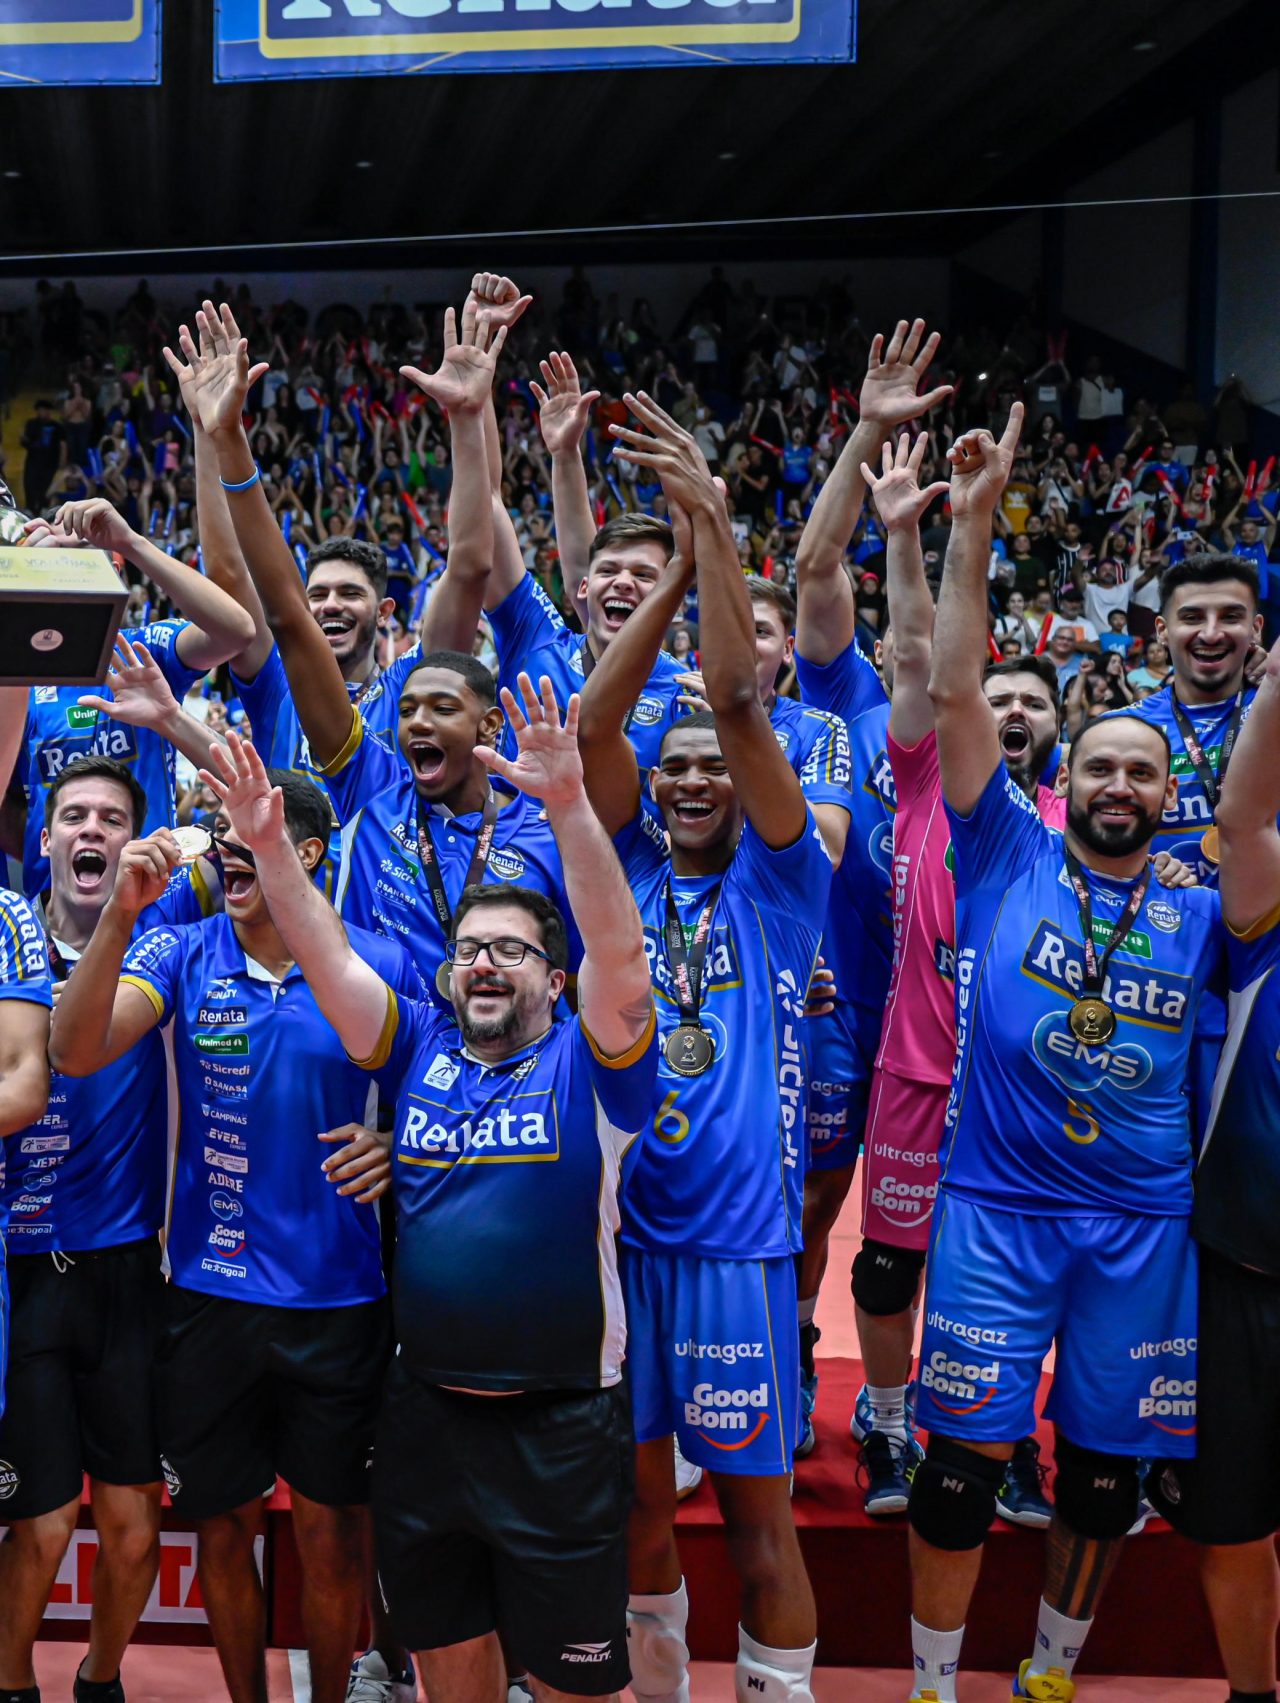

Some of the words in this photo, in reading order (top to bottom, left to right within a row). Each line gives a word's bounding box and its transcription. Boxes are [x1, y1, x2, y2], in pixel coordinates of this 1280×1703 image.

[73, 710, 98, 719] Unim
[42, 729, 130, 776] Reta
[1174, 751, 1216, 765] Und
[392, 822, 419, 851] Rena
[488, 851, 524, 873] Renata
[391, 866, 415, 885] Sicre
[1095, 894, 1125, 907] ALTY
[1147, 908, 1181, 922] Renata
[1092, 924, 1129, 942] nim
[207, 989, 237, 999] PENATY
[199, 1009, 245, 1023] Renata
[199, 1039, 231, 1047] Unimed
[1047, 1031, 1139, 1078] EMS
[212, 1063, 250, 1076] Sicredi
[811, 1081, 851, 1097] agaz
[210, 1110, 248, 1125] CAMPINAS
[653, 1091, 689, 1143] 6
[808, 1108, 848, 1126] ood
[1062, 1095, 1100, 1144] 5
[209, 1128, 239, 1145] EVER
[401, 1106, 549, 1153] Renata
[875, 1143, 938, 1167] ultraga
[208, 1172, 243, 1193] ADERE
[879, 1176, 938, 1199] Good
[11, 1201, 40, 1211] Bom
[19, 1194, 53, 1203] Good
[213, 1199, 239, 1213] EMS
[871, 1189, 921, 1214] Bom
[208, 1232, 235, 1249] Bom
[215, 1224, 245, 1240] Good
[927, 1311, 1008, 1345] ultragaz
[674, 1339, 764, 1365] ultragaz
[1130, 1337, 1198, 1360] ultraga
[930, 1351, 1000, 1383] Good
[921, 1365, 976, 1400] Bom
[1150, 1375, 1197, 1397] Goo
[693, 1383, 768, 1408] Good
[684, 1402, 748, 1430] Bom
[1138, 1397, 1197, 1418] Bom
[560, 1652, 610, 1664] PENALTY
